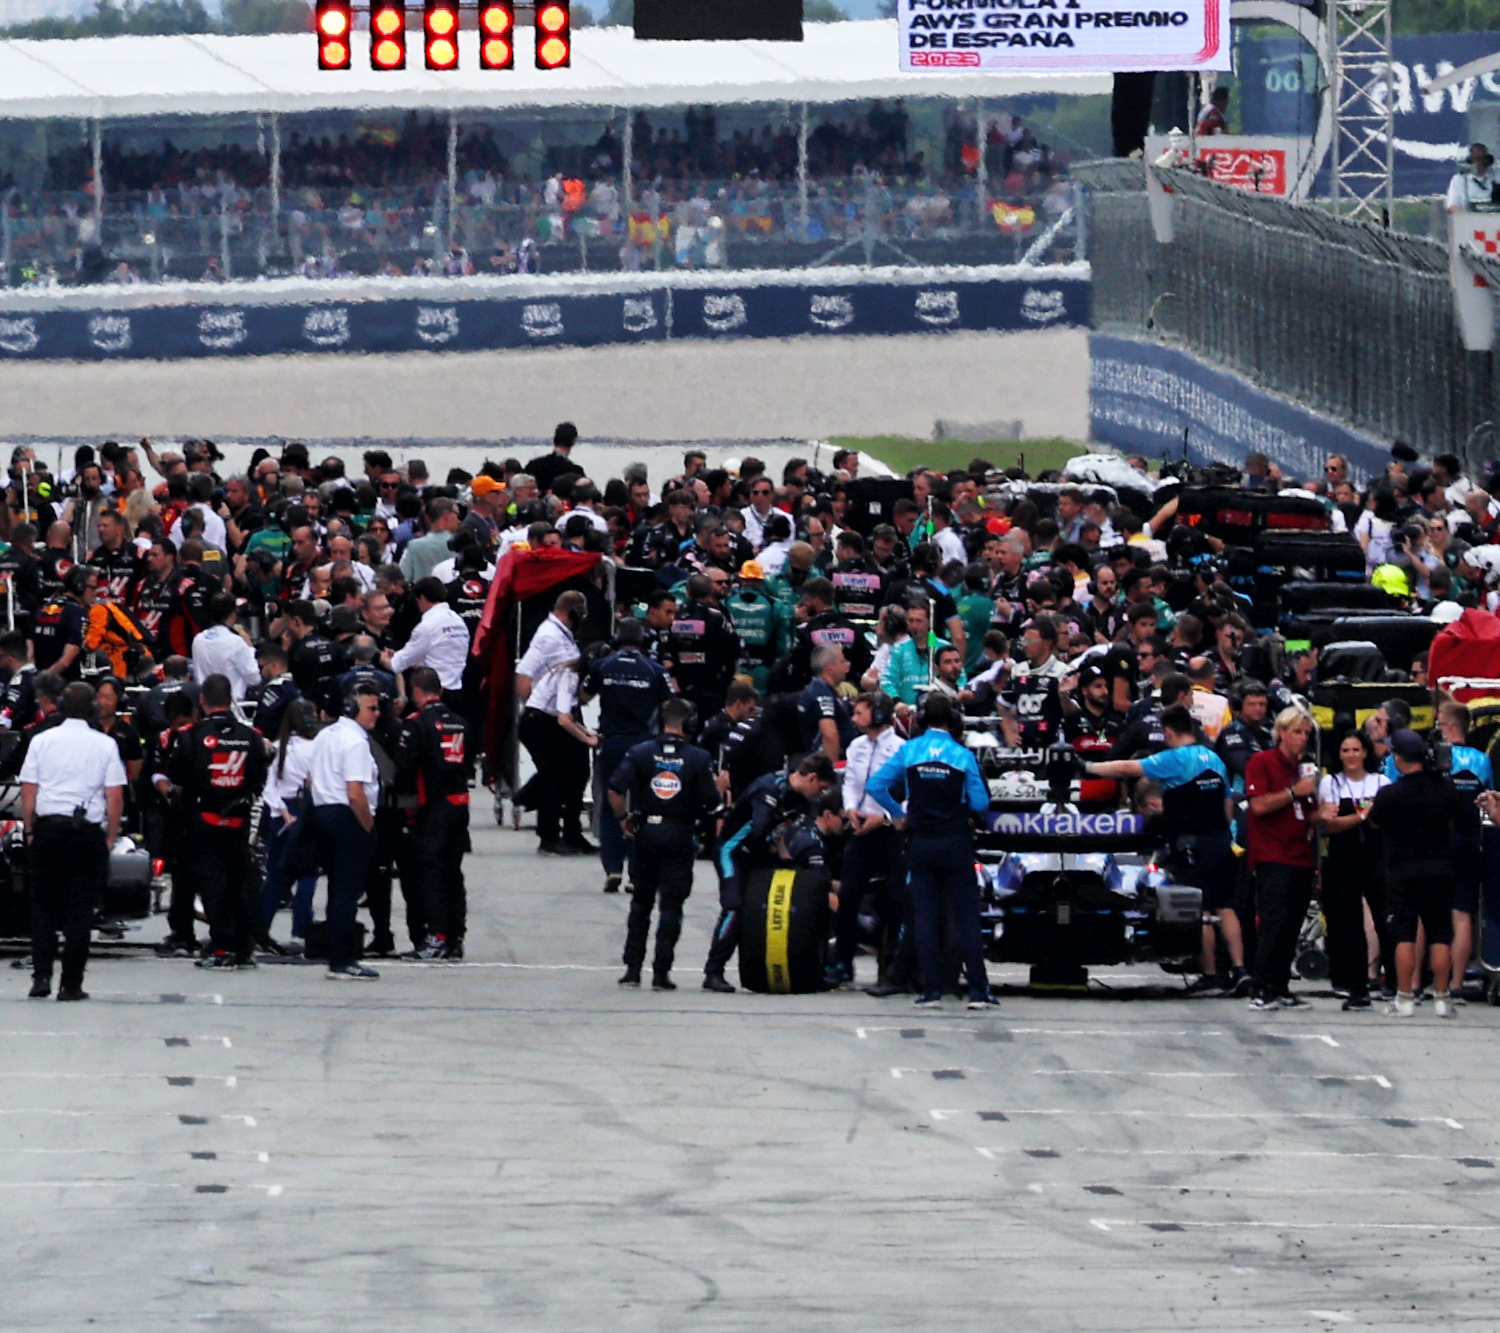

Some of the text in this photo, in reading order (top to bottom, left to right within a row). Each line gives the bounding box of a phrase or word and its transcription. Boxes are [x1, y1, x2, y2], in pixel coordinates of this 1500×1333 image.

[909, 11, 1188, 30] AWS GRAN PREMIO
[909, 29, 1075, 49] DE ESPAÑA
[910, 52, 981, 66] 2023
[1023, 811, 1137, 834] kraken
